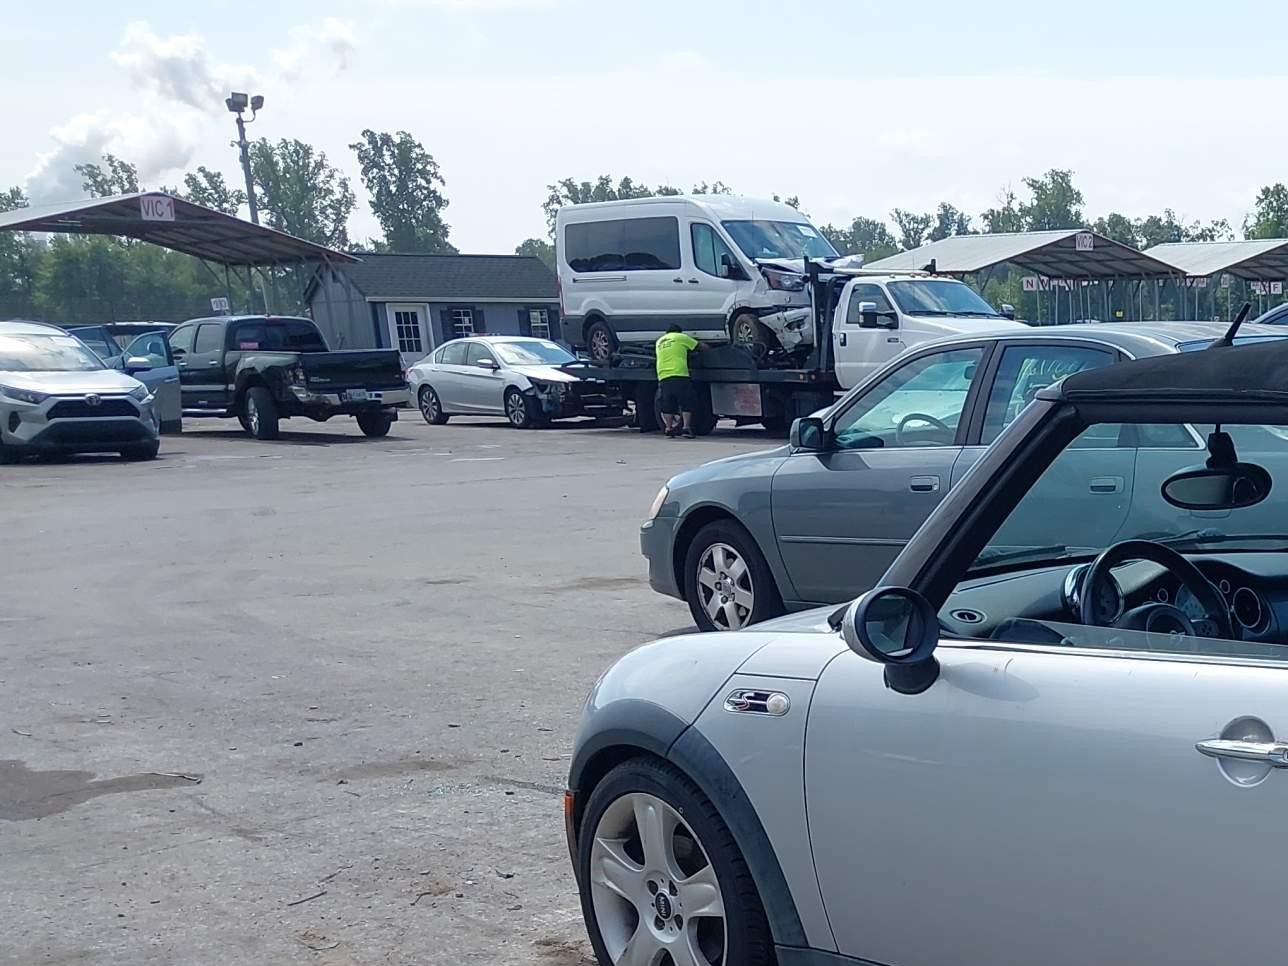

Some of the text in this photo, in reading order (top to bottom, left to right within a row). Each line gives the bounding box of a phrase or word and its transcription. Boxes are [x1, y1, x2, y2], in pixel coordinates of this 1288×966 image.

[142, 199, 173, 218] VIC 1
[1026, 279, 1034, 289] N
